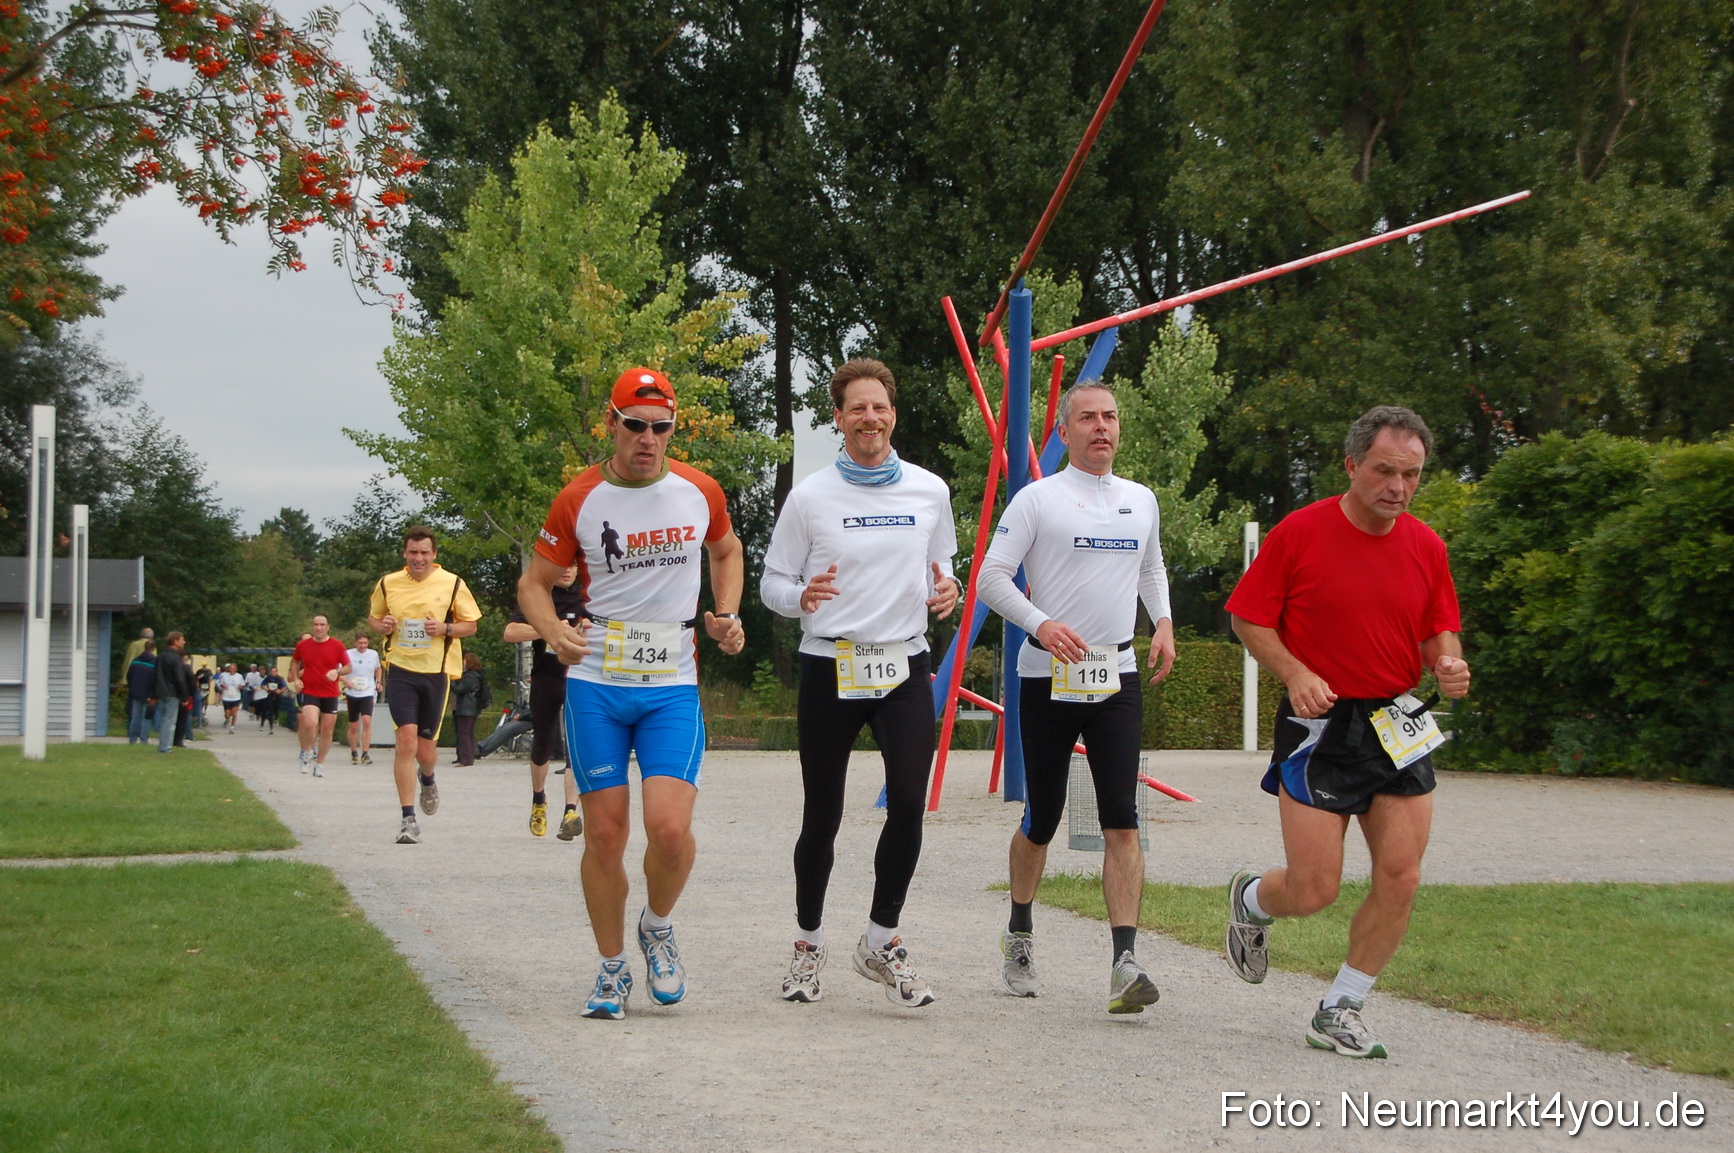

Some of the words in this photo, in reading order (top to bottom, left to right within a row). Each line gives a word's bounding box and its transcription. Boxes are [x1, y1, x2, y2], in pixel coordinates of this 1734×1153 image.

[540, 528, 559, 546] ERZ
[627, 525, 696, 549] MERZ
[624, 541, 684, 559] Reisen
[619, 558, 656, 572] TEAM
[659, 555, 688, 567] 2008
[407, 630, 426, 639] 333
[627, 628, 650, 643] Jörg
[632, 647, 668, 664] 434
[855, 644, 885, 657] Stefan
[839, 662, 846, 672] C
[863, 662, 897, 679] 116
[1054, 665, 1060, 675] C
[1078, 668, 1108, 684] 119
